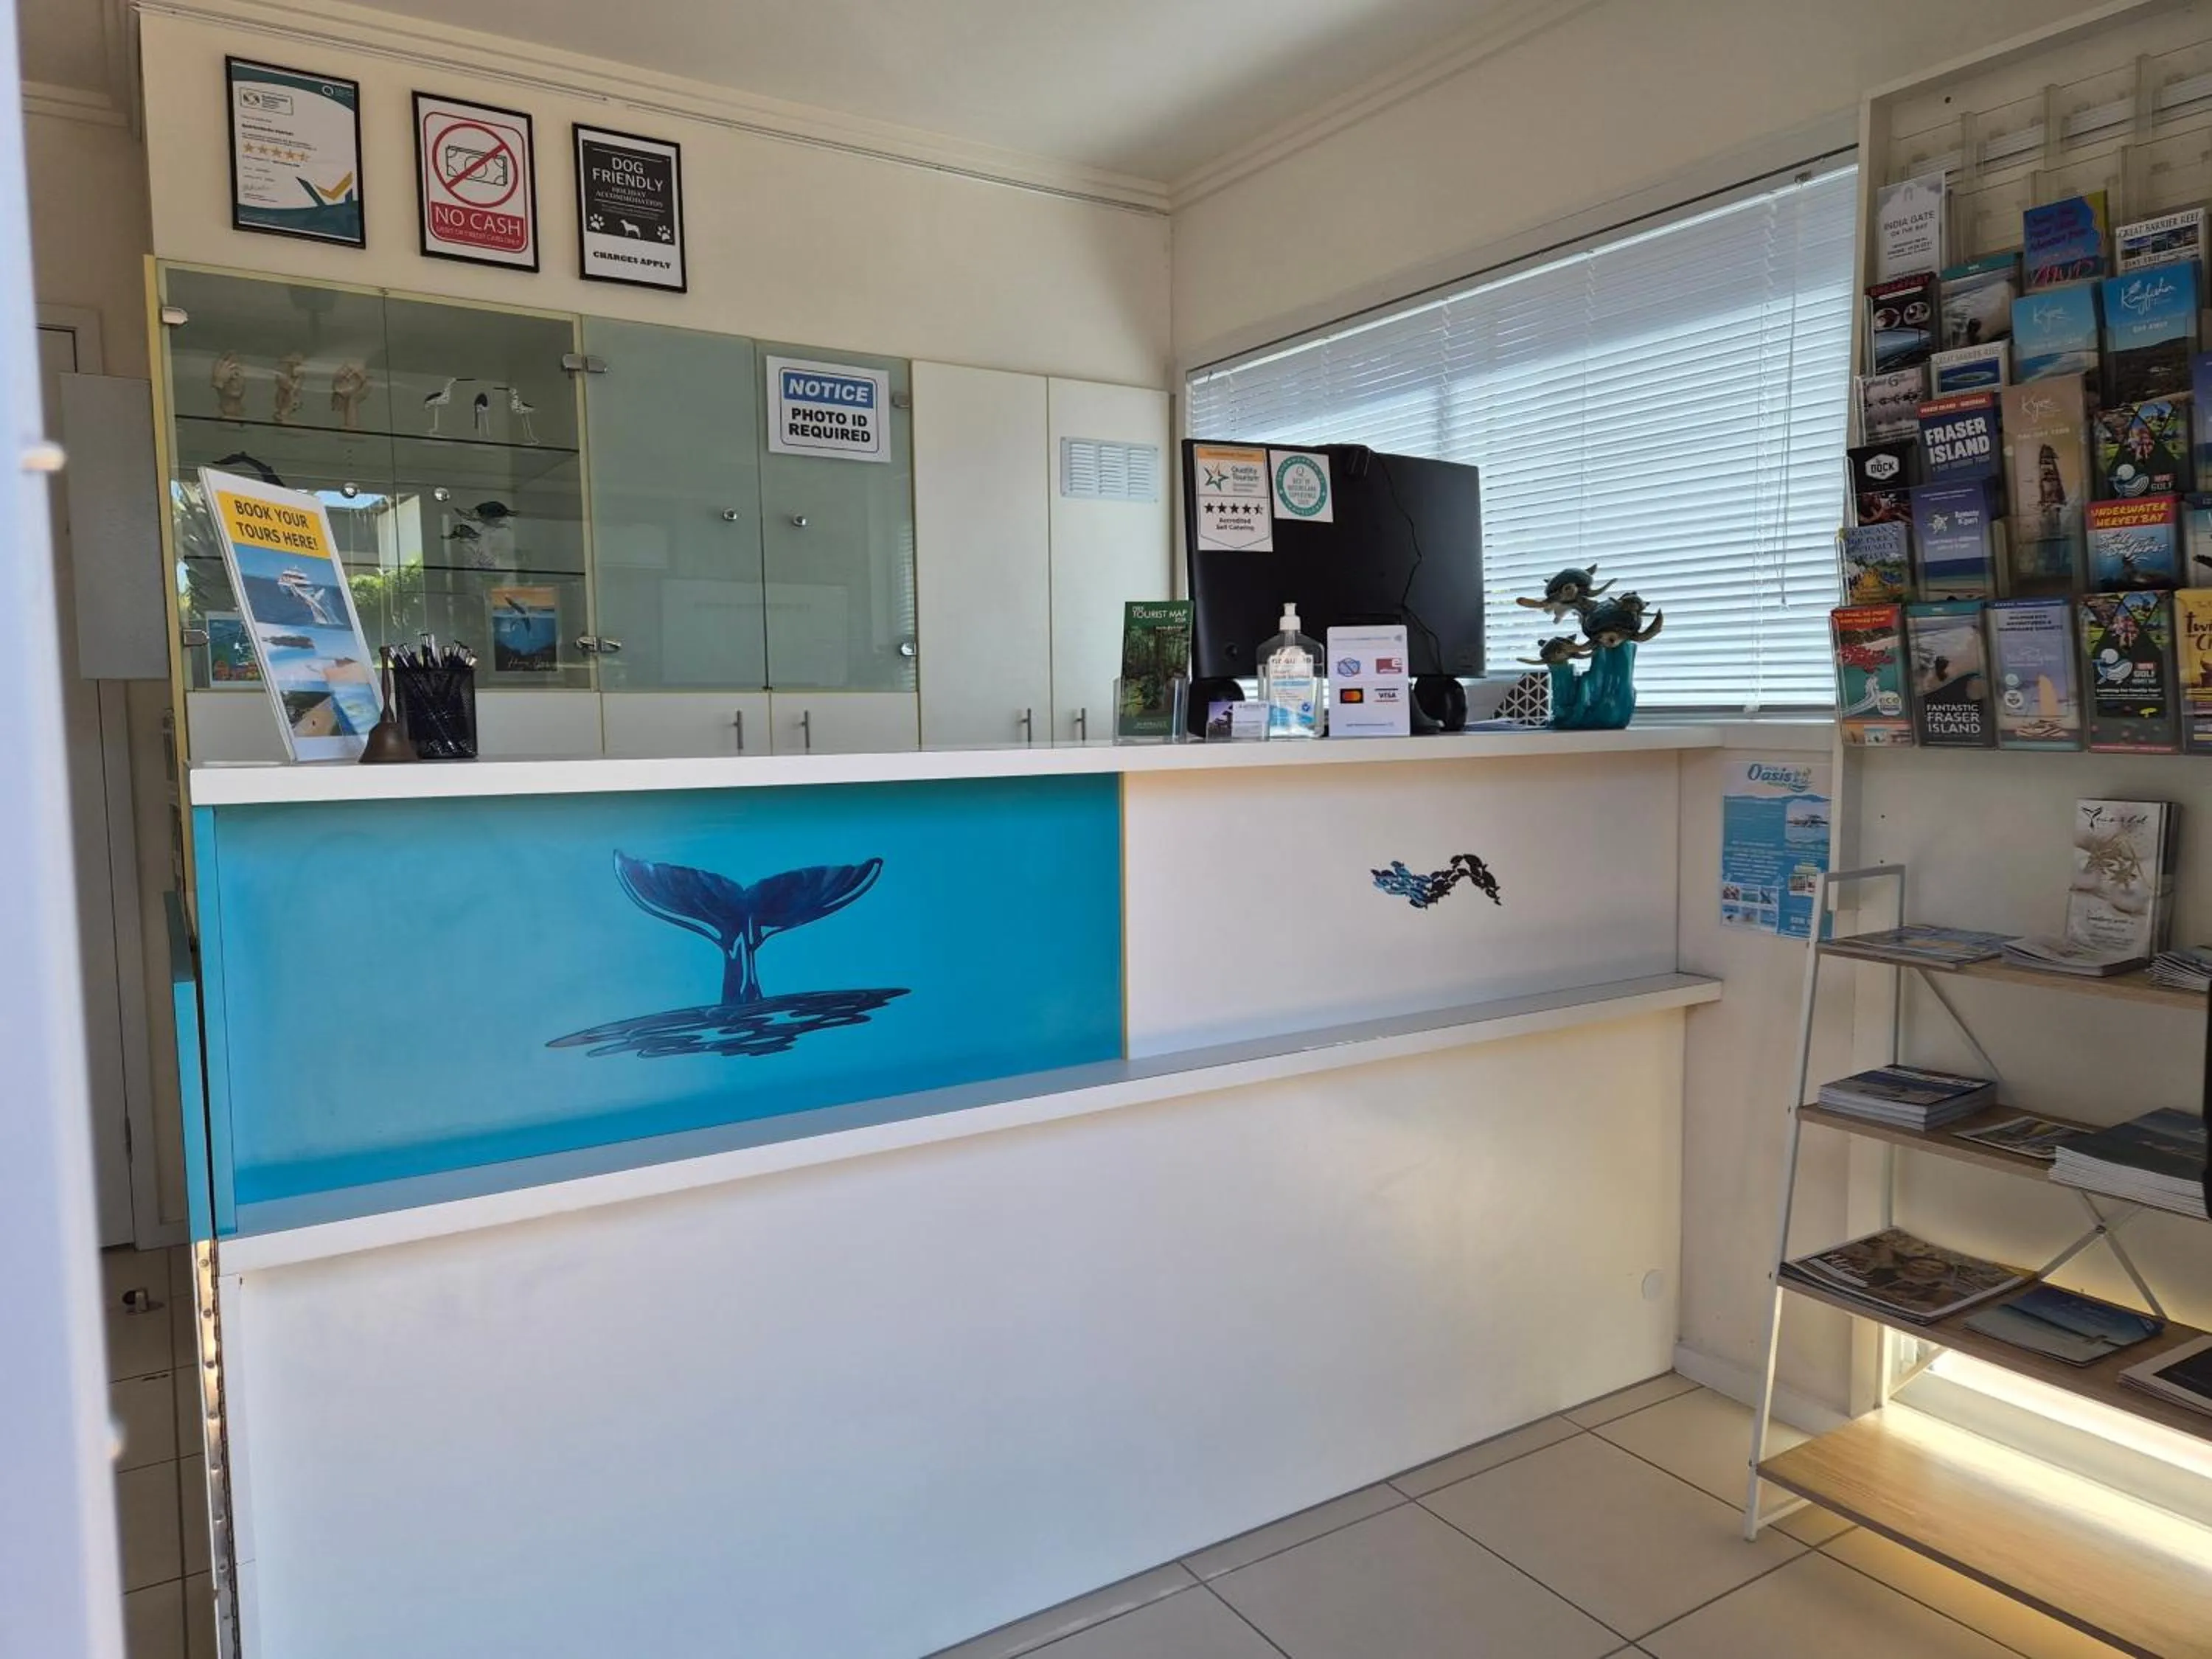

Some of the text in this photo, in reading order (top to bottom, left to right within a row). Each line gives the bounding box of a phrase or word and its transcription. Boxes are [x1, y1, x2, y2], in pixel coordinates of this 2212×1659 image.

[612, 157, 644, 175] DOG
[592, 167, 664, 192] FRIENDLY
[436, 206, 465, 226] NO
[470, 213, 521, 237] CASH
[1884, 210, 1935, 230] INDIA GATE
[593, 251, 672, 269] CHARGES APPLY
[788, 378, 869, 403] NOTICE
[791, 408, 868, 427] PHOTO ID
[788, 422, 871, 442] REQUIRED
[1924, 417, 1987, 445] FRASER
[1928, 435, 1991, 465] ISLAND
[1871, 462, 1895, 473] DOCK
[234, 500, 309, 529] BOOK YOUR
[2090, 501, 2171, 515] UNDERWATER
[2096, 513, 2164, 526] HERVEY BAY
[235, 521, 319, 550] TOURS HERE!
[1132, 610, 1188, 619] TOURIST MAP
[1927, 703, 1979, 712] FANTASTIC
[1927, 712, 1980, 723] FRASER
[1928, 723, 1981, 734] ISLAND
[1747, 763, 1793, 782] Oasis
